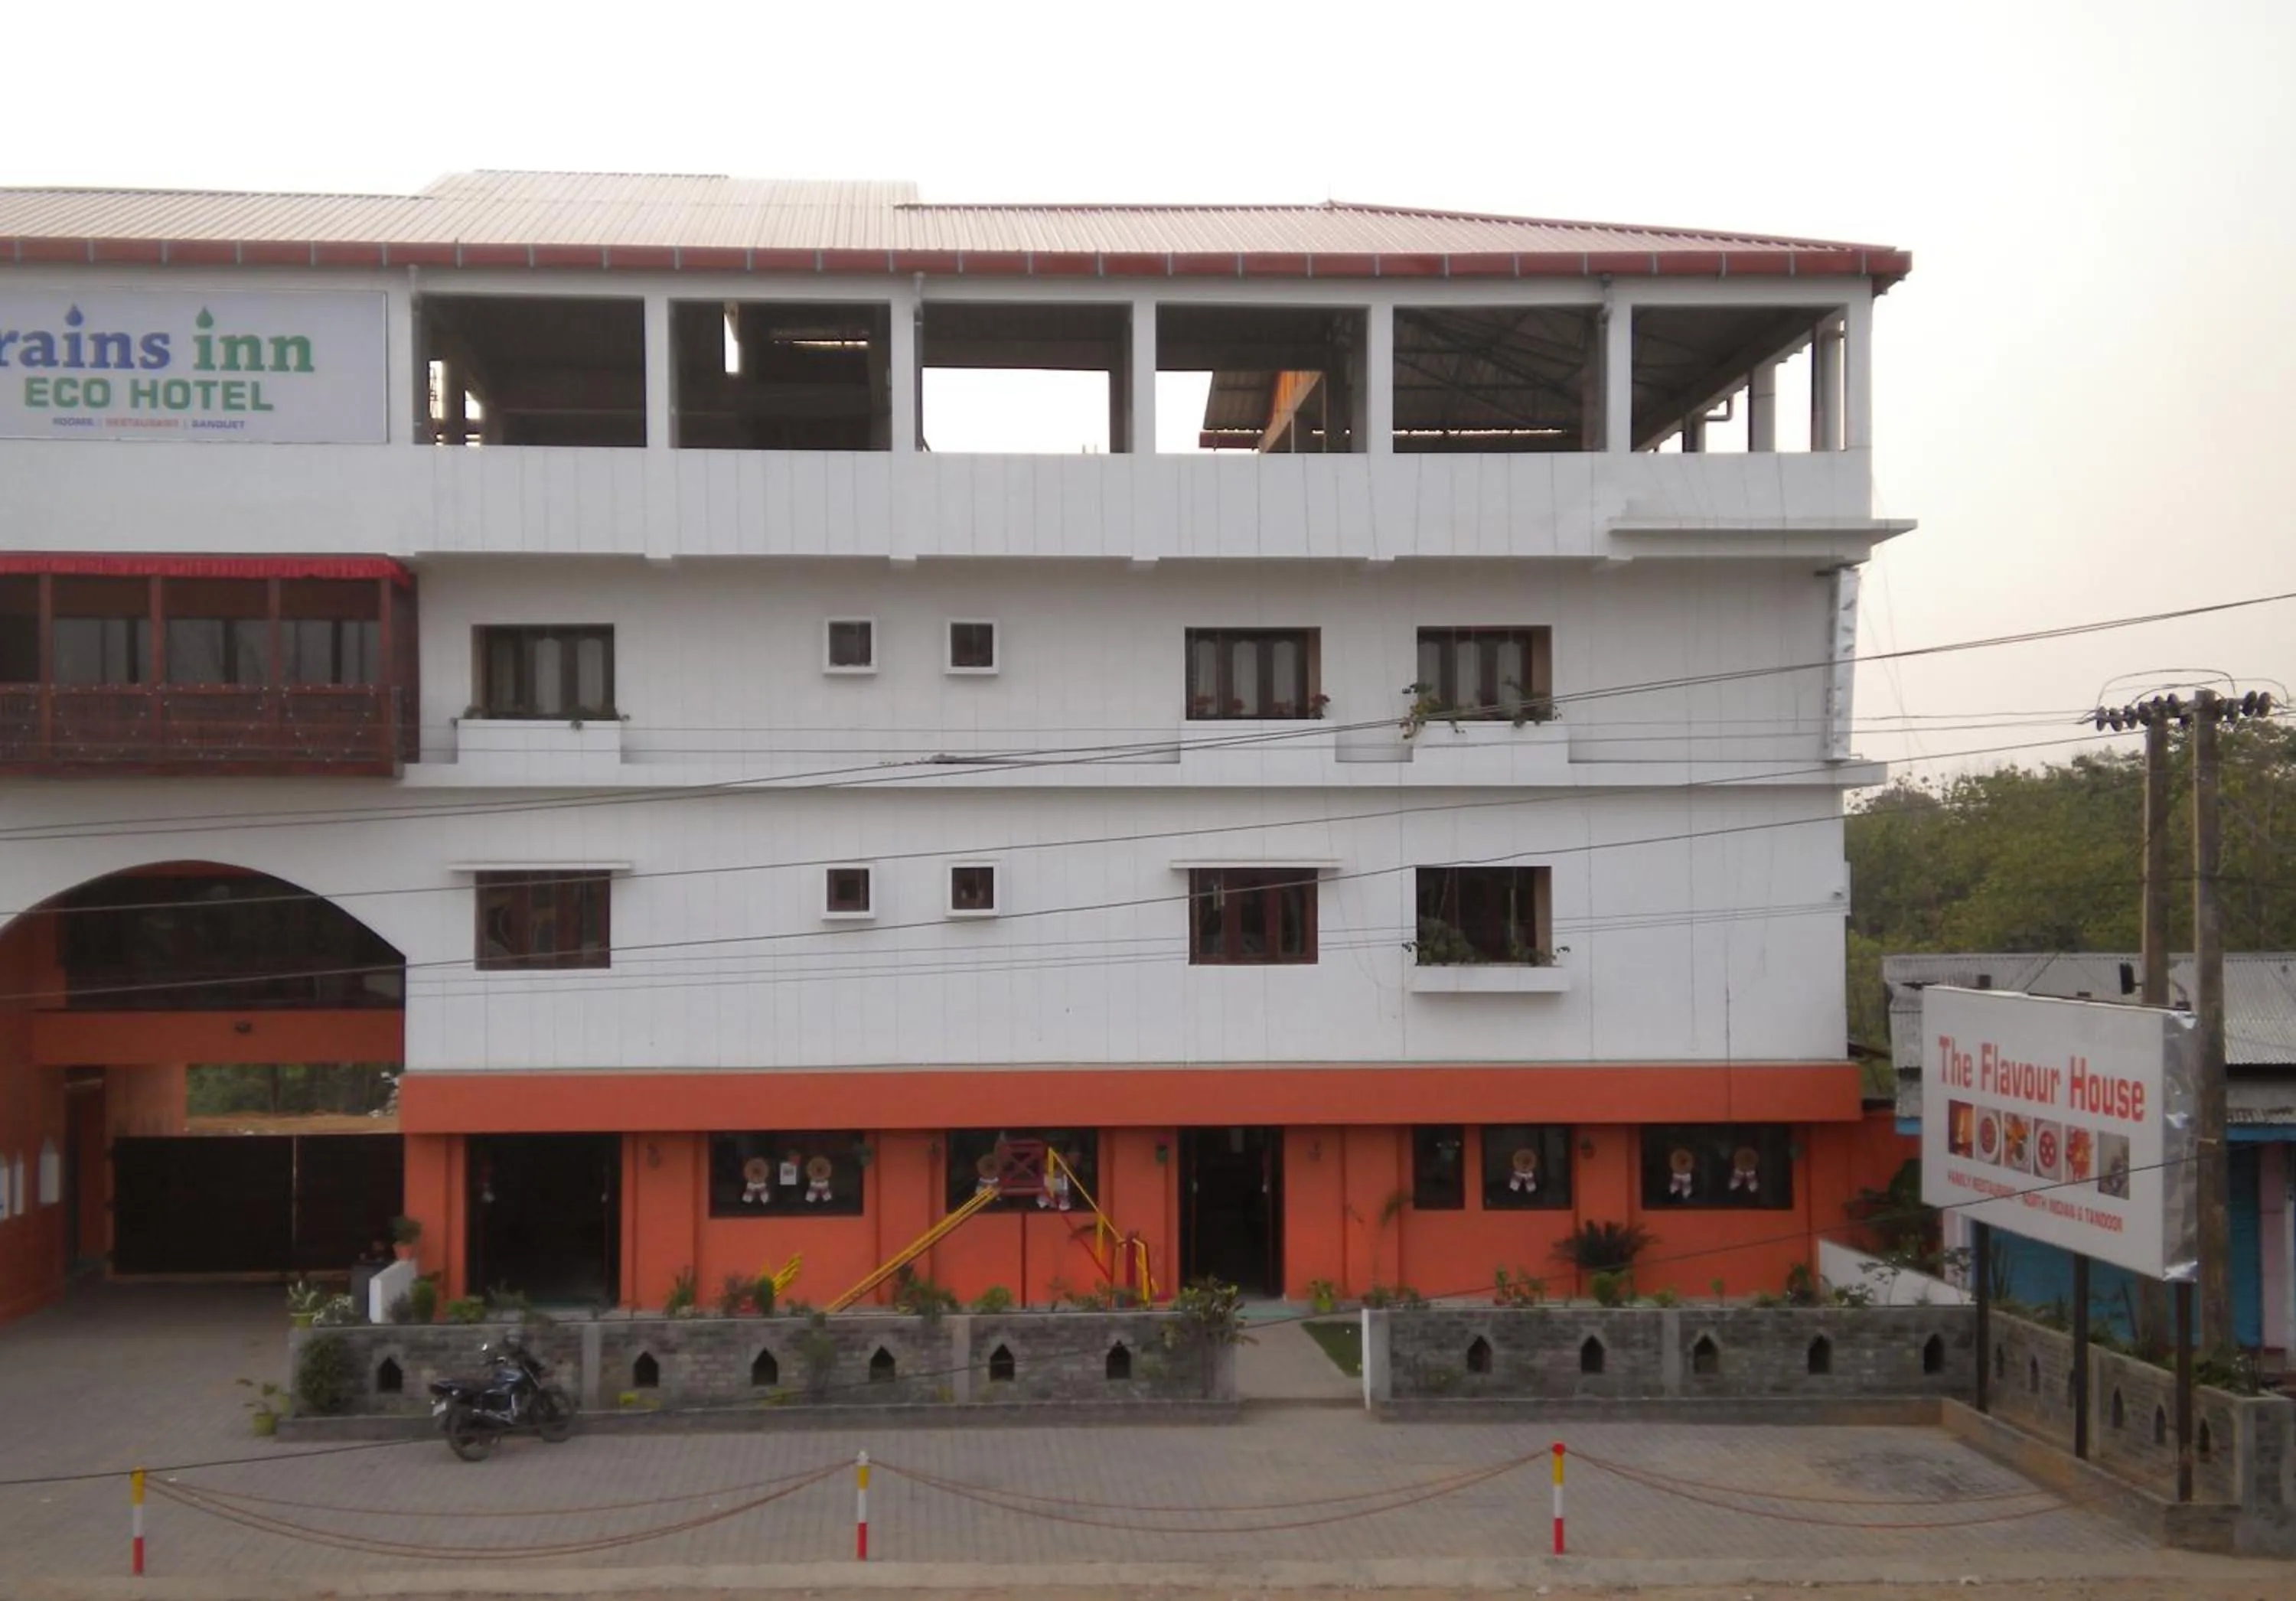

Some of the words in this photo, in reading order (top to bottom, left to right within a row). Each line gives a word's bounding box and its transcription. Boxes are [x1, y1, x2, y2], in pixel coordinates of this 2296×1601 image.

[193, 305, 315, 372] inn
[24, 377, 111, 408] ECO
[129, 380, 274, 412] HOTEL
[191, 420, 245, 430] BANQUET
[1939, 1035, 1972, 1089] The
[1981, 1043, 2060, 1105] Flavour
[2069, 1056, 2145, 1123] House
